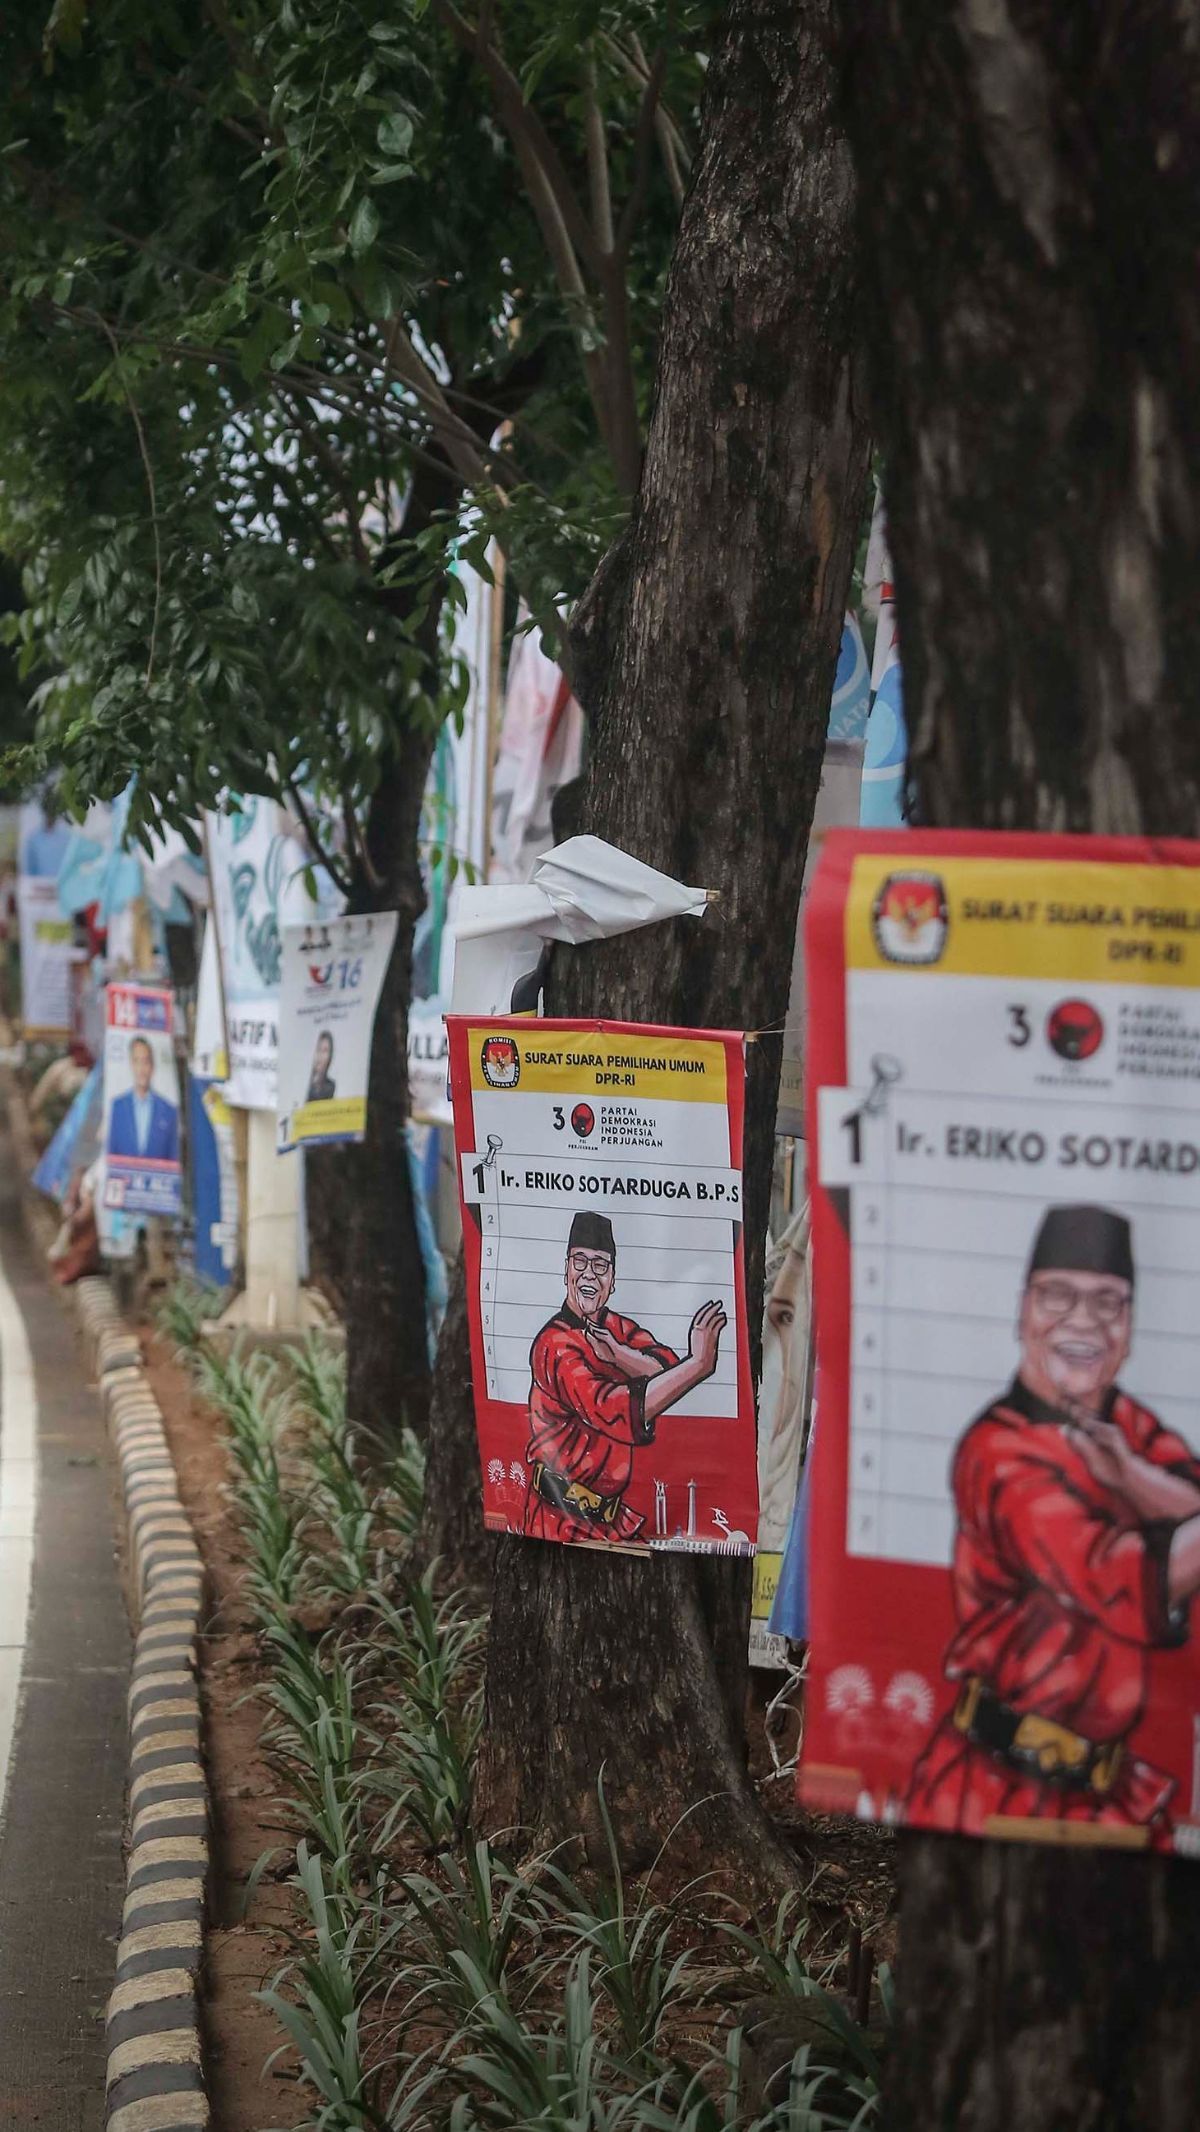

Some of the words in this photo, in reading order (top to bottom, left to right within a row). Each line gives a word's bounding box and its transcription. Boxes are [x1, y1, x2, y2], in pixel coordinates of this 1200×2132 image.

[962, 898, 1037, 923] SURAT
[1046, 901, 1125, 927] SUARA
[339, 957, 363, 989] 16
[1007, 1003, 1032, 1048] 3
[524, 1052, 564, 1065] SURAT
[565, 1053, 604, 1067] SUARA
[606, 1055, 666, 1071] PEMILIHAN
[669, 1058, 705, 1074] UMUM
[595, 1072, 636, 1086] DPR-RI
[601, 1106, 638, 1116] PARTAI
[552, 1106, 566, 1131] 3
[601, 1116, 657, 1127] DEMOKRASI
[278, 1115, 289, 1143] 1
[601, 1126, 653, 1137] INDONESIA
[600, 1136, 663, 1148] PERJUANGAN
[841, 1109, 862, 1166] 1
[896, 1121, 934, 1155] Ir.
[946, 1123, 1046, 1165] ERIKO
[472, 1163, 485, 1194] 1
[500, 1169, 520, 1188] Ir.
[525, 1171, 575, 1192] ERIKO
[579, 1174, 692, 1199] SOTARDUGA
[696, 1182, 739, 1203] B.P.S
[487, 1215, 494, 1225] 2
[486, 1247, 493, 1257] 3
[484, 1282, 490, 1292] 4
[485, 1315, 490, 1325] 5
[490, 1379, 496, 1390] 7
